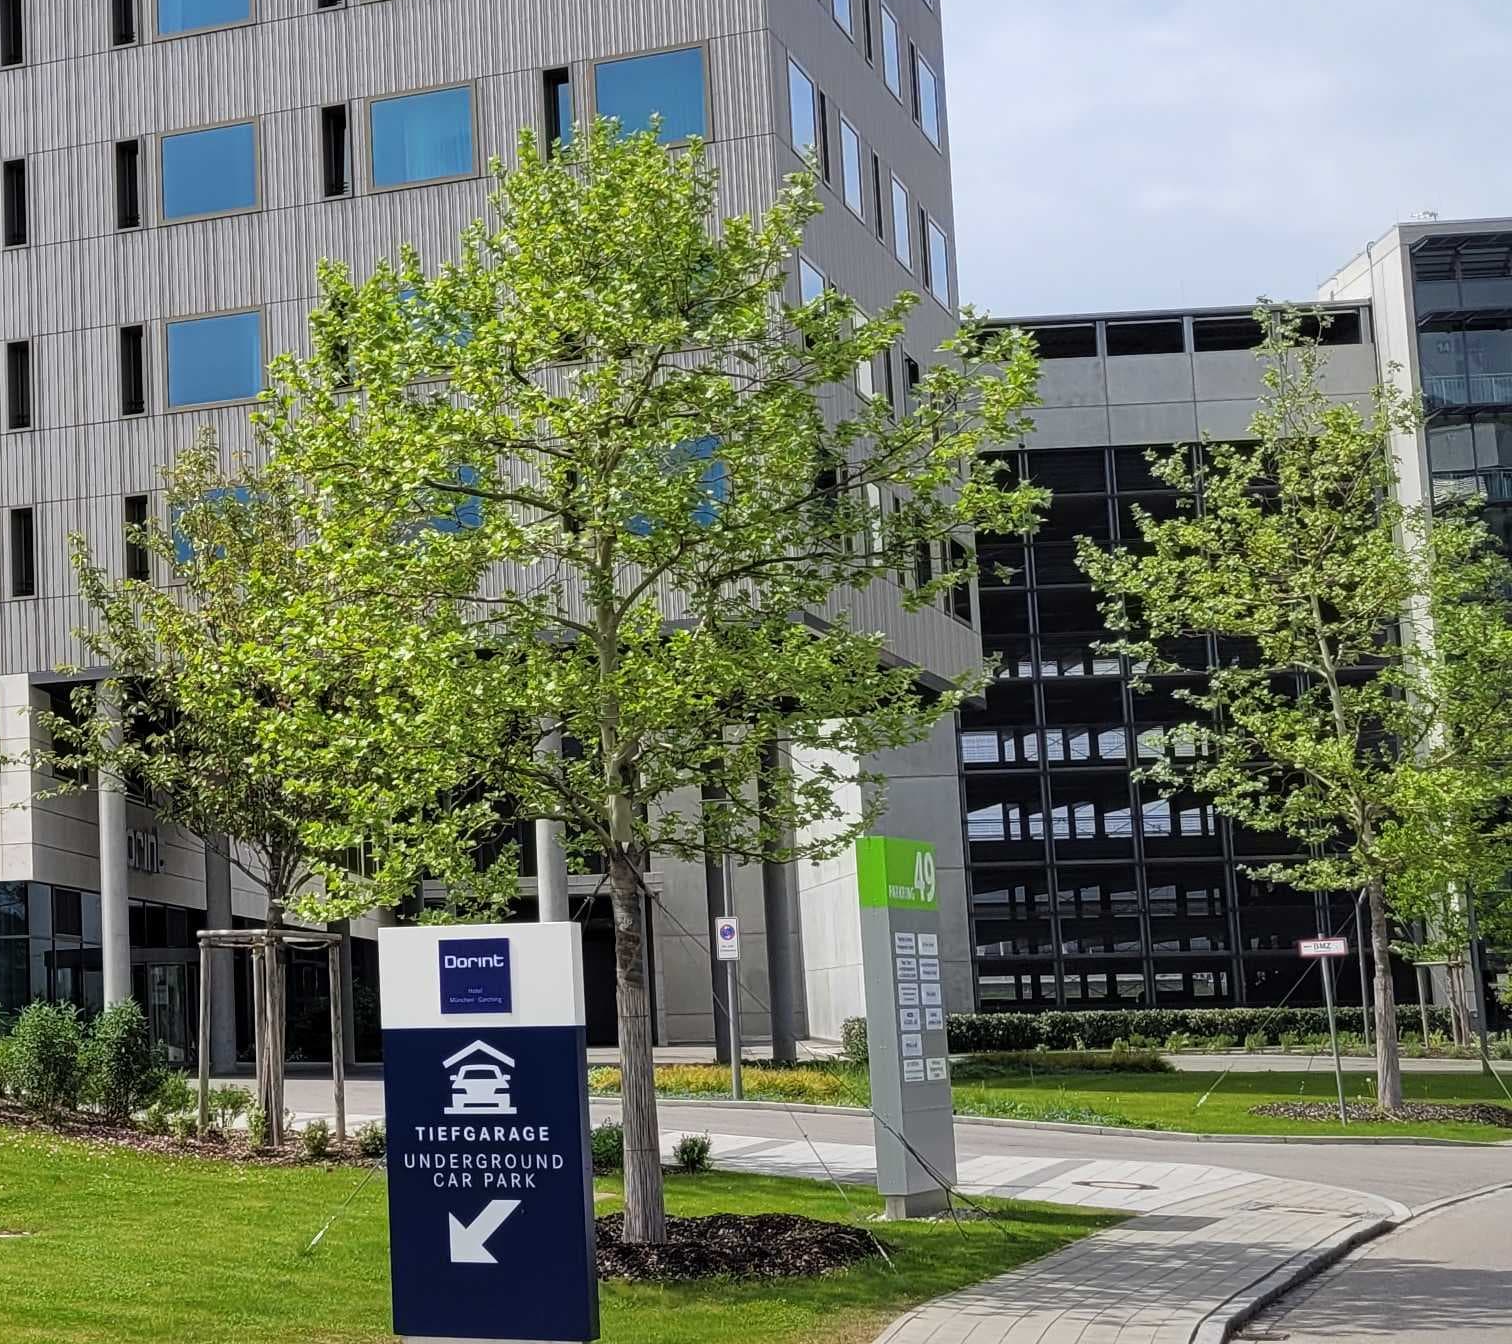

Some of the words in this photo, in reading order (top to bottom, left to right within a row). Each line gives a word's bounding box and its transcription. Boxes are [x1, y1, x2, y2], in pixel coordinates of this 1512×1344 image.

[914, 851, 935, 902] 49
[444, 954, 504, 968] Dorint
[415, 1126, 550, 1142] TIEFGARAGE
[404, 1153, 564, 1170] UNDERGROUND
[433, 1172, 473, 1188] CAR
[484, 1172, 536, 1188] PARK
